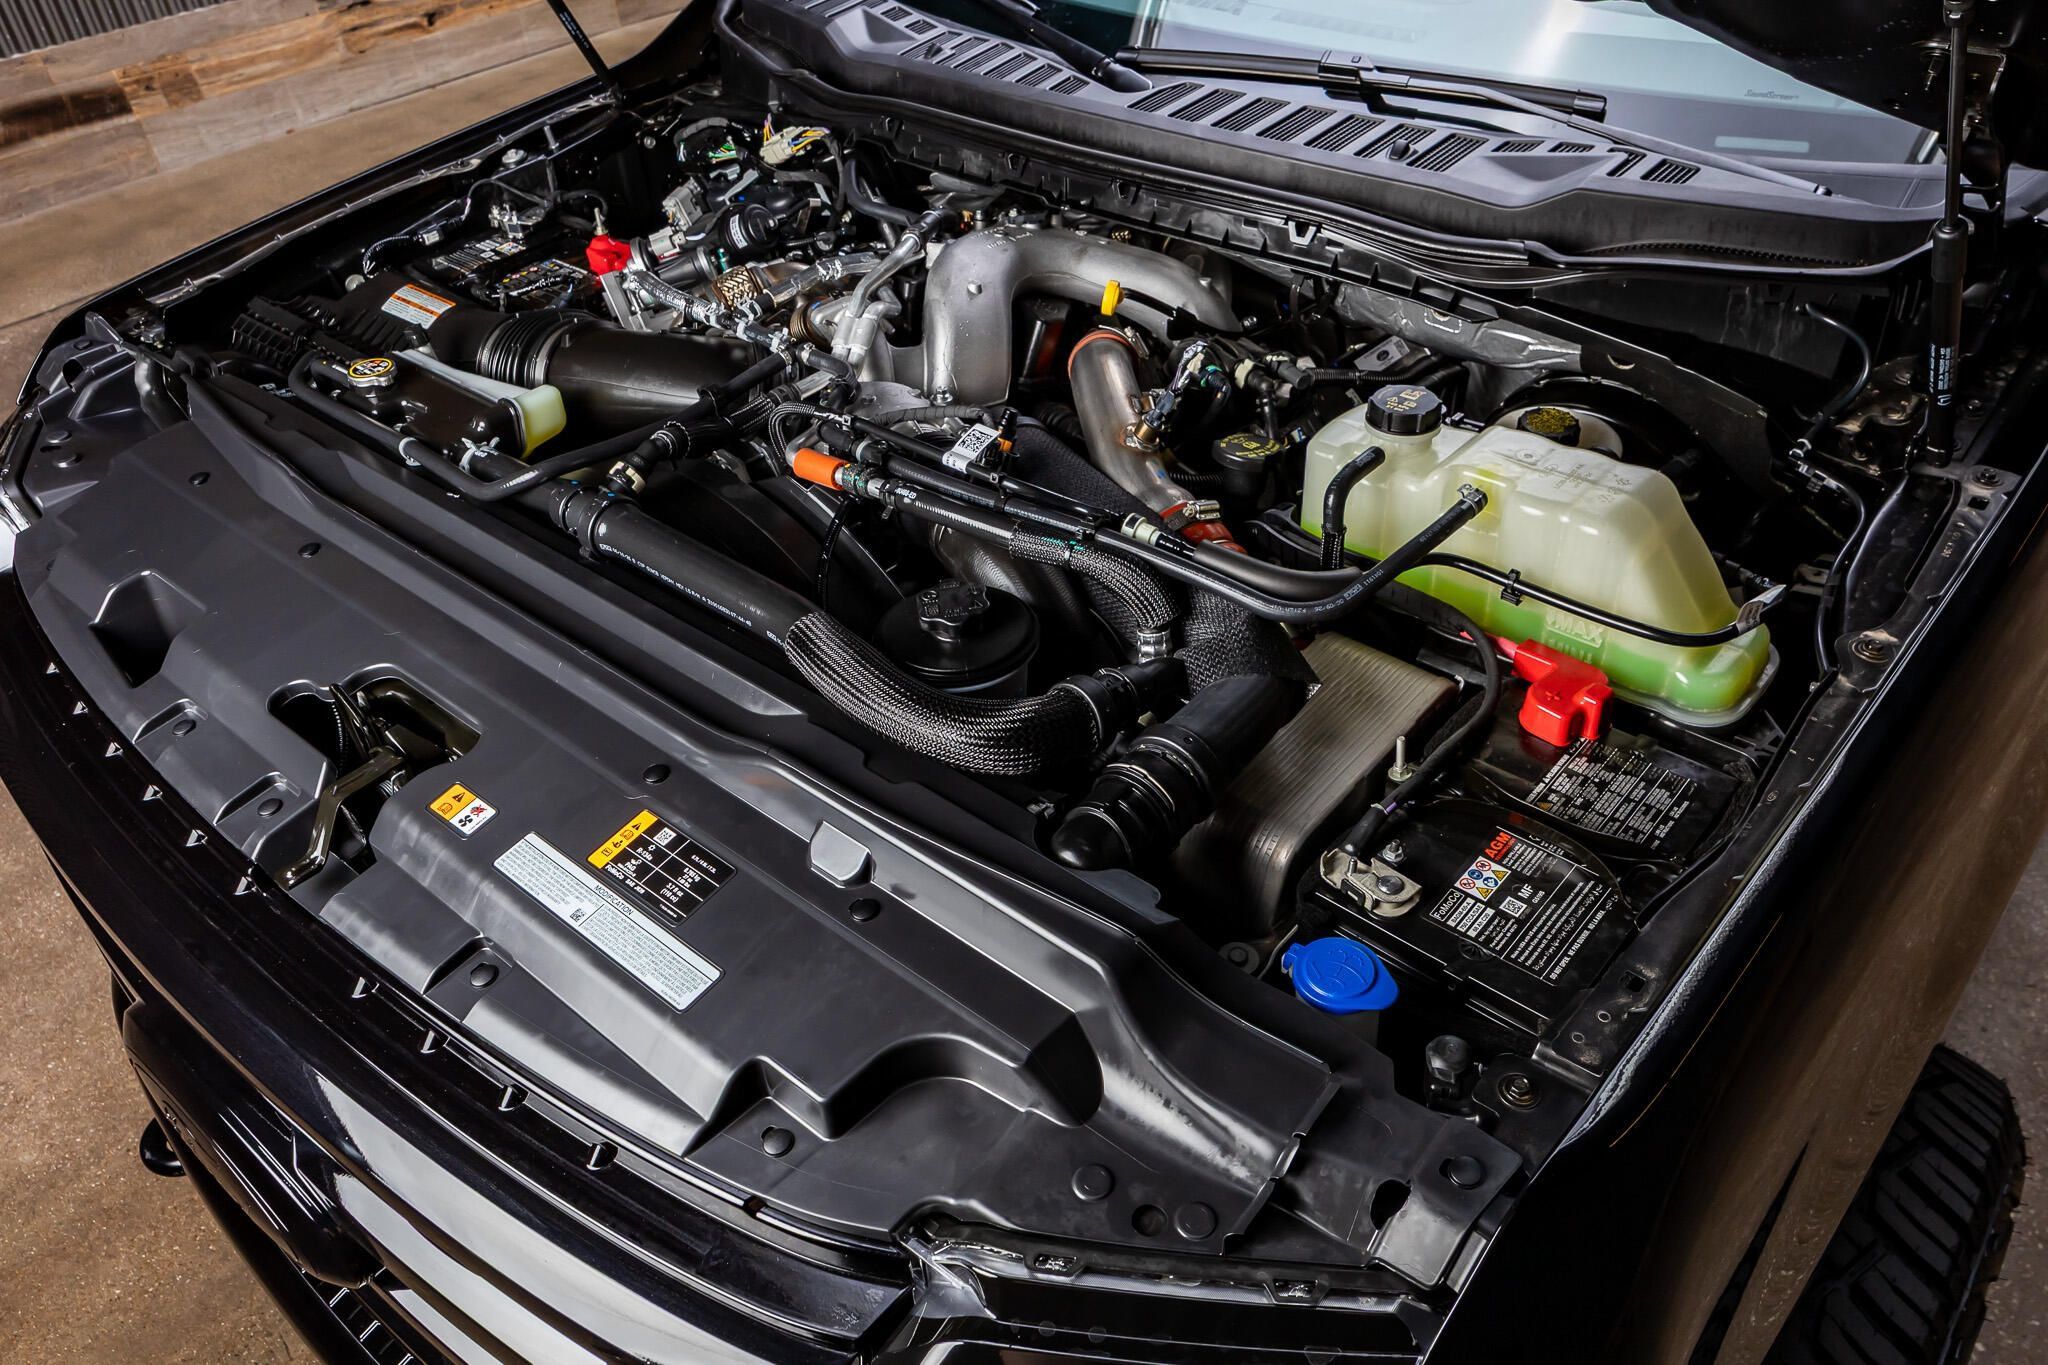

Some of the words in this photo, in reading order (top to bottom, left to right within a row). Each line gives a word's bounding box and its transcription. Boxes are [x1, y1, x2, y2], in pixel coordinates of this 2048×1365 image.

[636, 847, 653, 861] R-134a
[1485, 832, 1511, 858] AGM
[605, 864, 624, 880] FoMoCo
[594, 884, 634, 916] MODIFICATION
[1518, 884, 1533, 899] MF
[1433, 890, 1461, 919] FoMoCo
